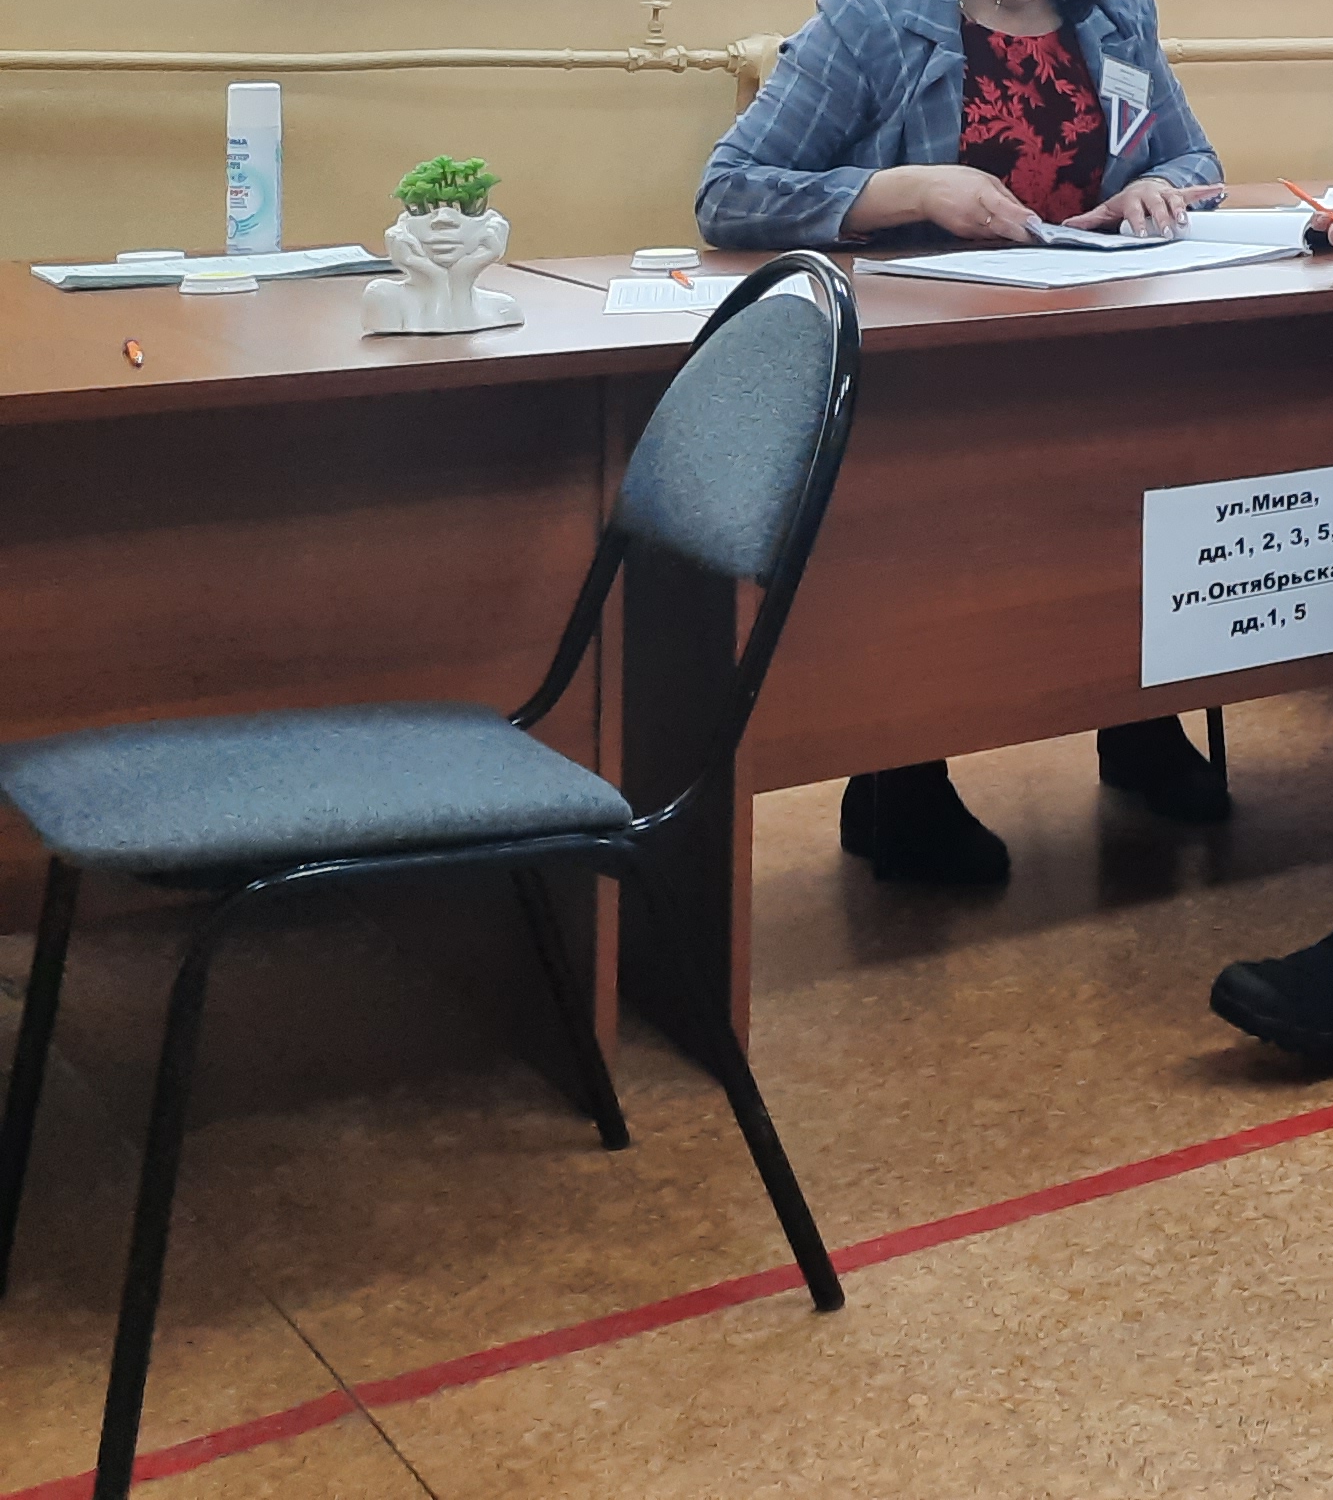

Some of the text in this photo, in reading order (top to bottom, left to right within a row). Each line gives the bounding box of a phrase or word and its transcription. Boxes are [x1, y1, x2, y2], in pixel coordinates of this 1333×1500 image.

[1216, 490, 1319, 523] ул.Мира,
[1198, 537, 1254, 565] дд.1,
[1262, 532, 1282, 552] 2,
[1290, 527, 1309, 547] 3,
[1231, 603, 1306, 637] дд.1, 5
